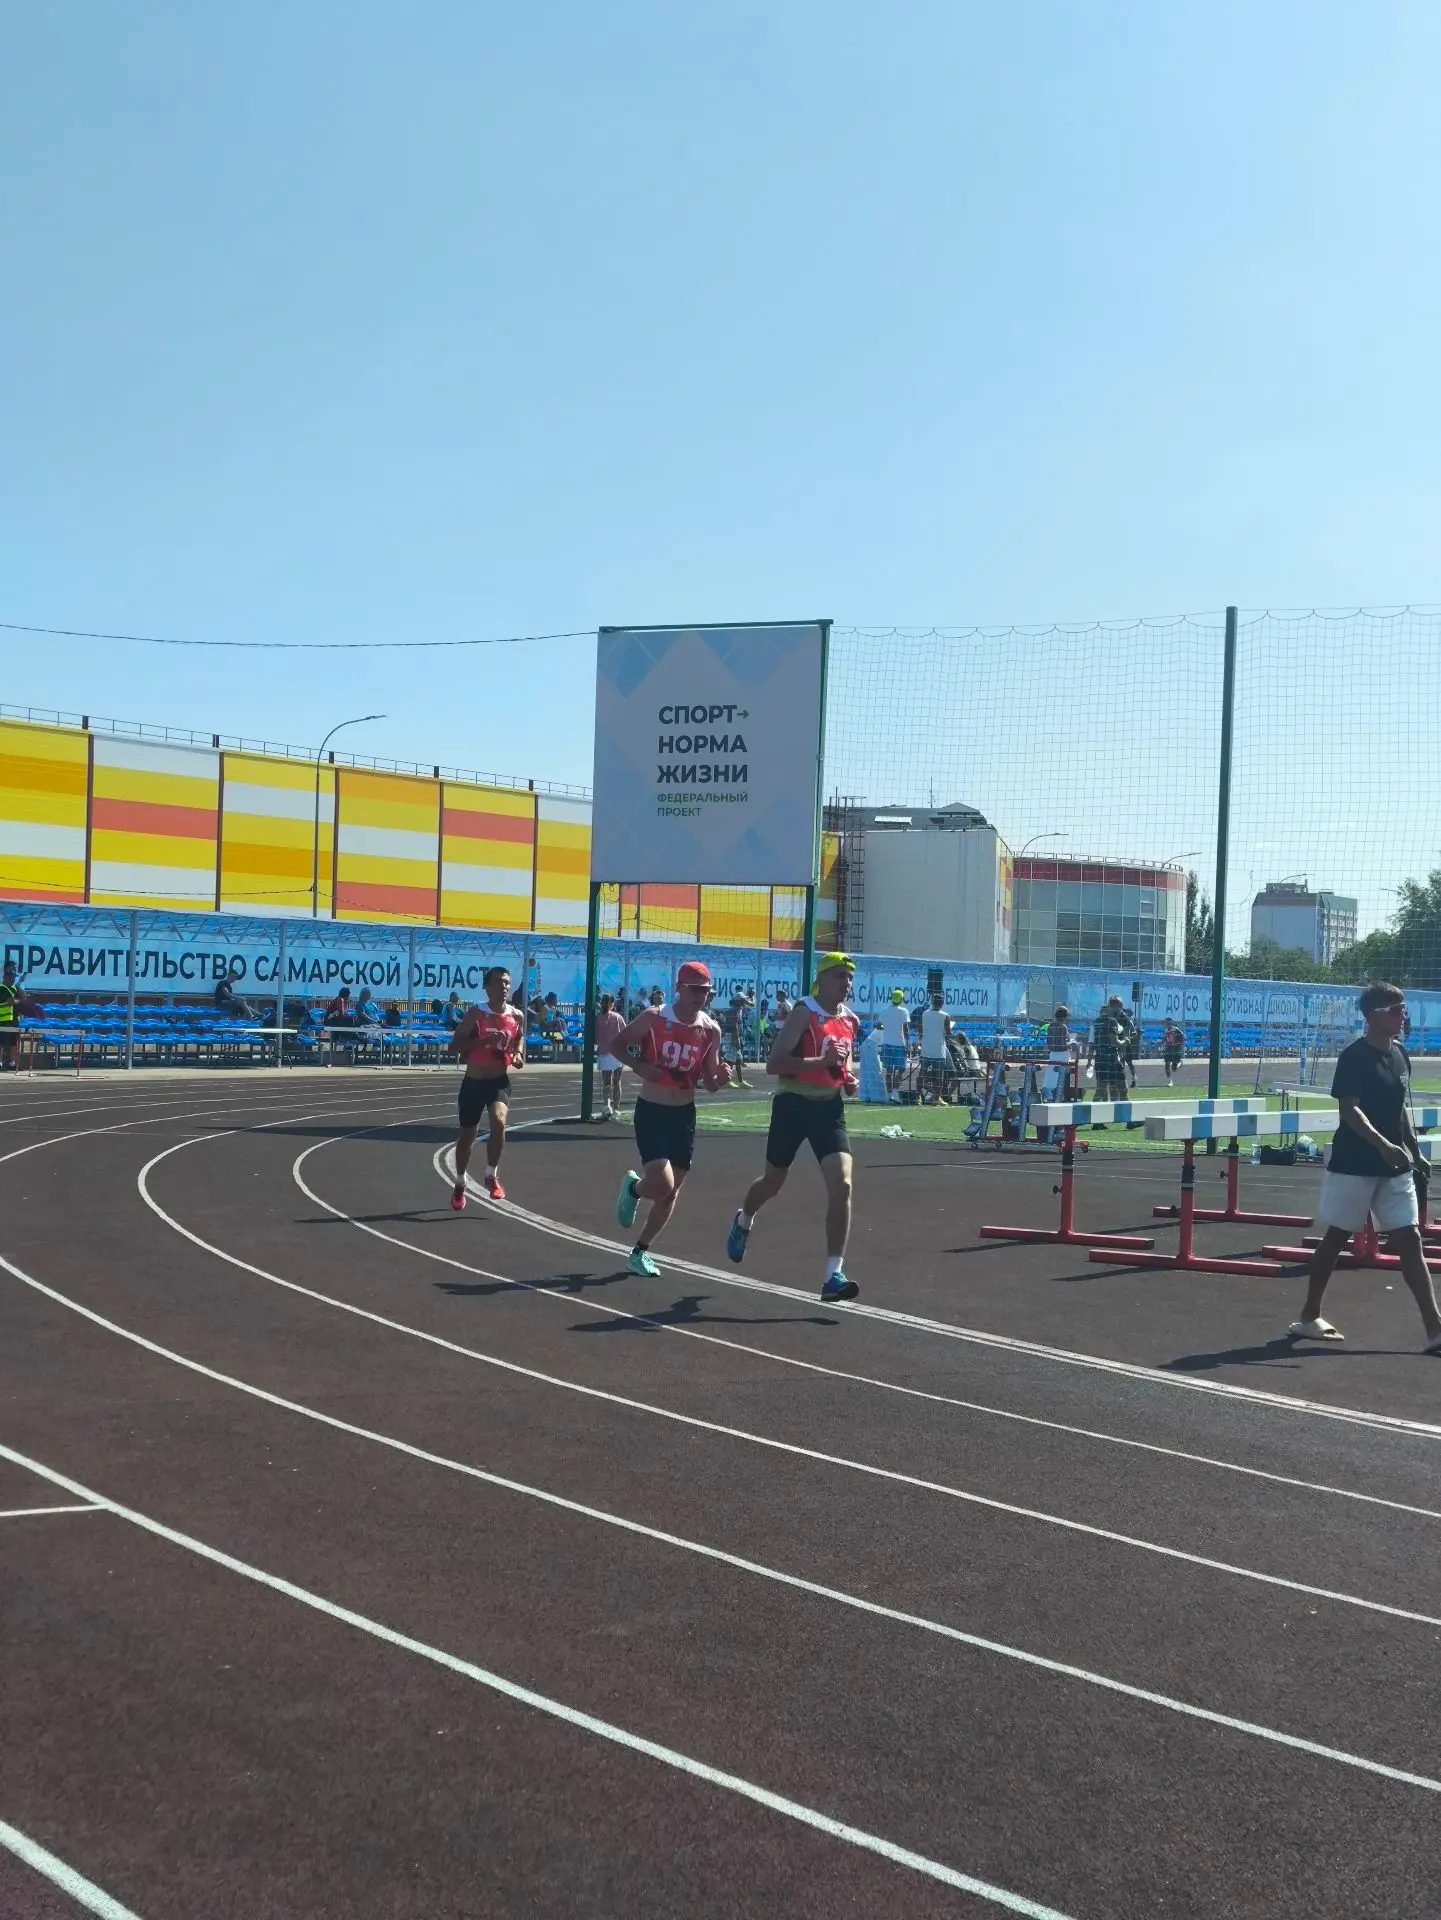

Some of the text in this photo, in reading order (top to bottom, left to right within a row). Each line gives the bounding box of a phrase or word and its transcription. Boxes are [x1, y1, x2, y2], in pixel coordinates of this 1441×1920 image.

[658, 704, 738, 725] СПОРТ
[658, 734, 748, 754] НОРМА
[657, 764, 748, 784] ЖИЗНИ
[657, 792, 748, 804] ФЕДЕРАЛЬНЫЙ
[657, 807, 702, 817] ПРОЕКТ
[4, 943, 490, 990] ПРАВИТЕЛЬСТВО САМАРСКОЙ ОБЛАСТ
[943, 986, 988, 1006] БЛАСТИ
[1166, 994, 1181, 1014] ДО
[1186, 995, 1199, 1012] СО
[661, 1034, 699, 1072] 95
